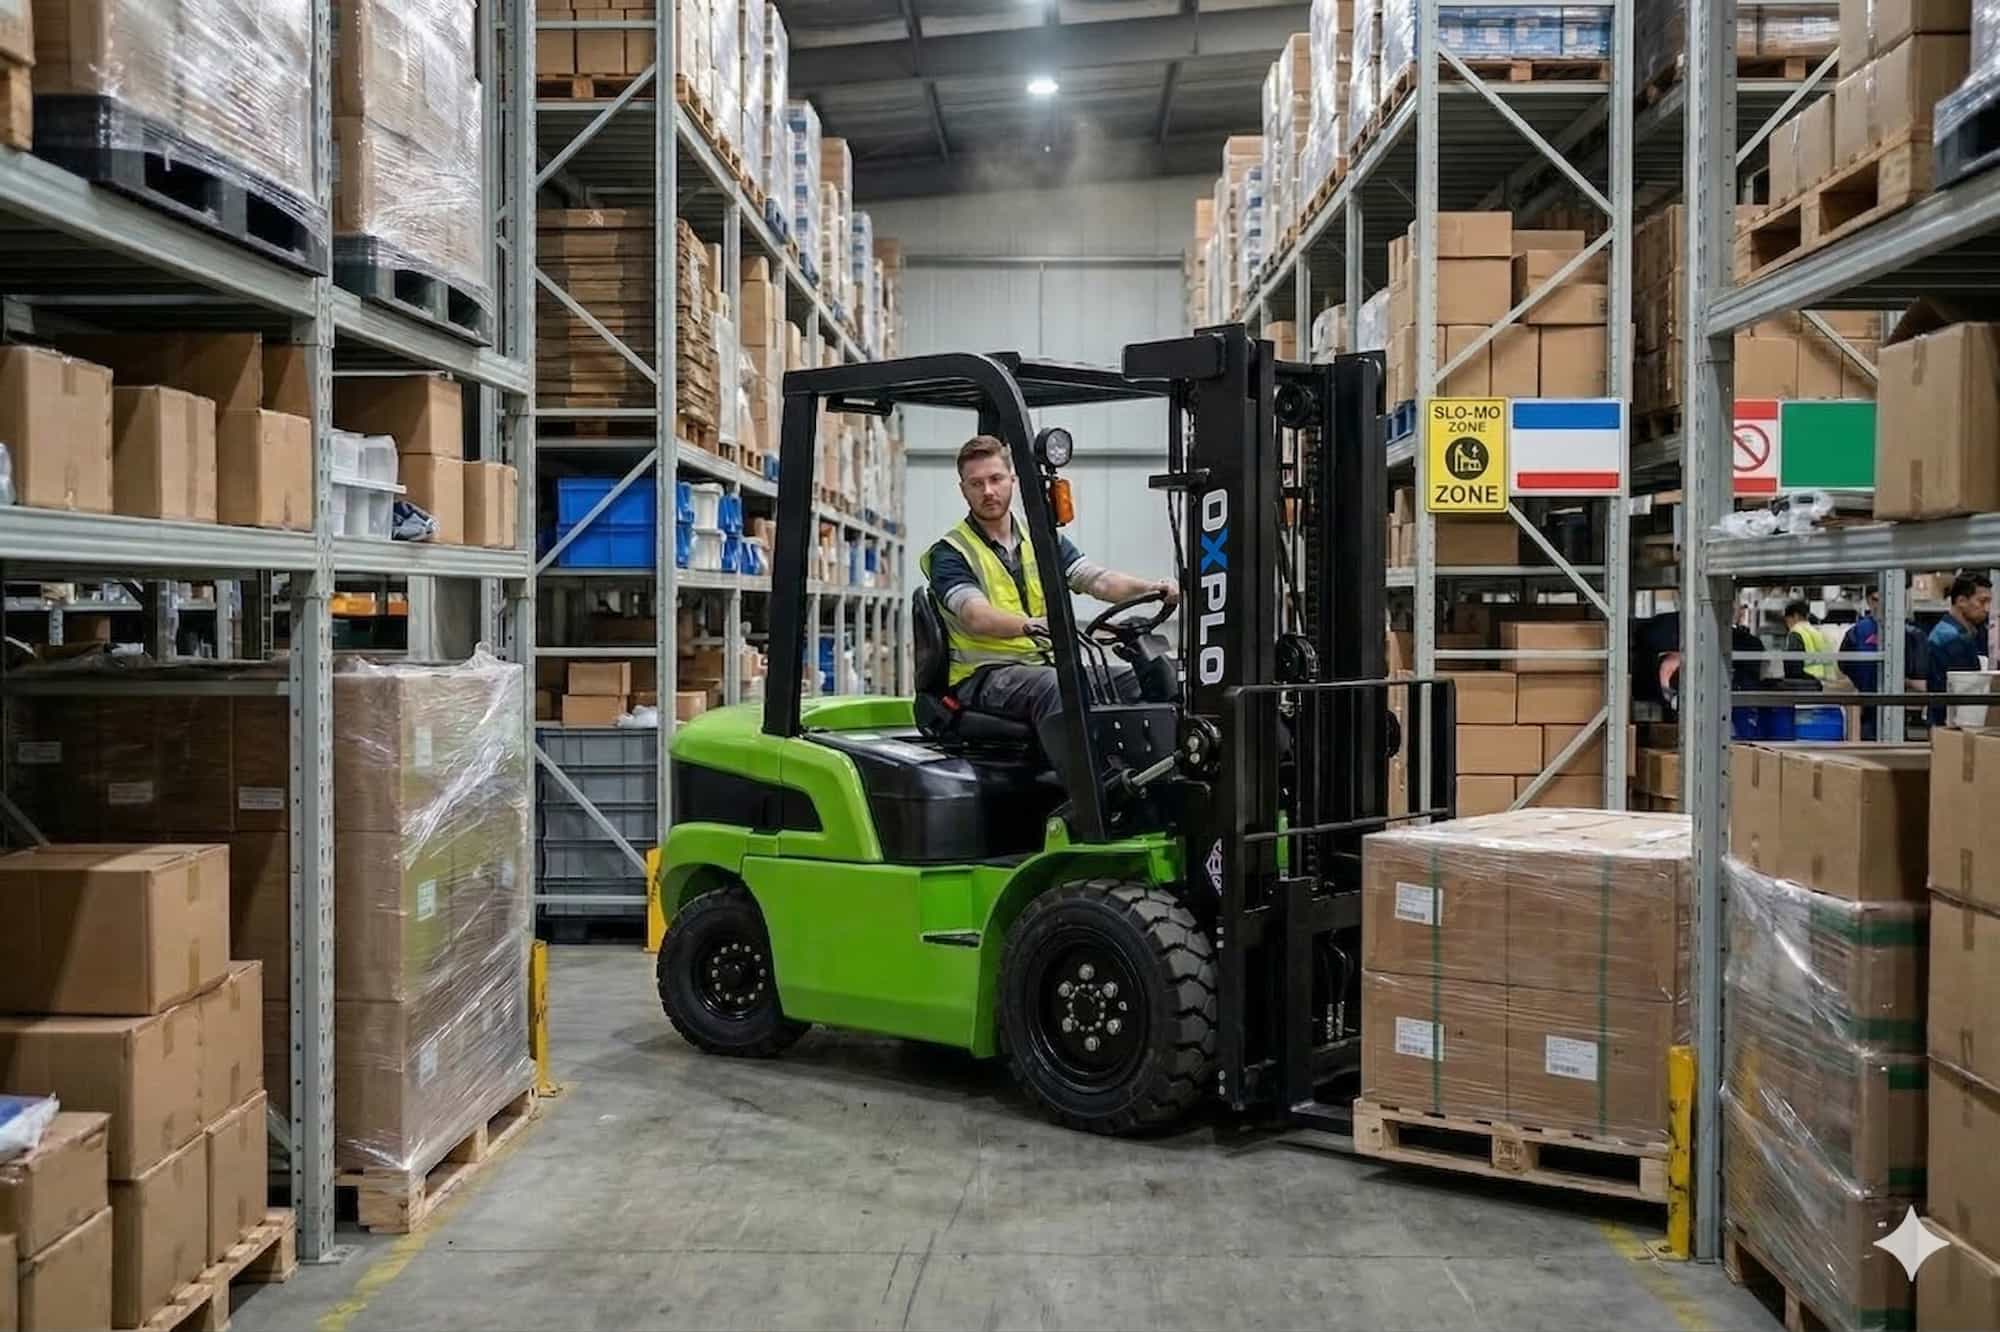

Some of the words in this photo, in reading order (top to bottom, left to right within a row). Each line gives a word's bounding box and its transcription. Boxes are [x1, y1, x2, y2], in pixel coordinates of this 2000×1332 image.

[1434, 407, 1501, 419] SLO-MO
[1448, 422, 1486, 432] ZONE
[1435, 486, 1498, 503] ZONE
[1200, 488, 1229, 686] OXPLO
